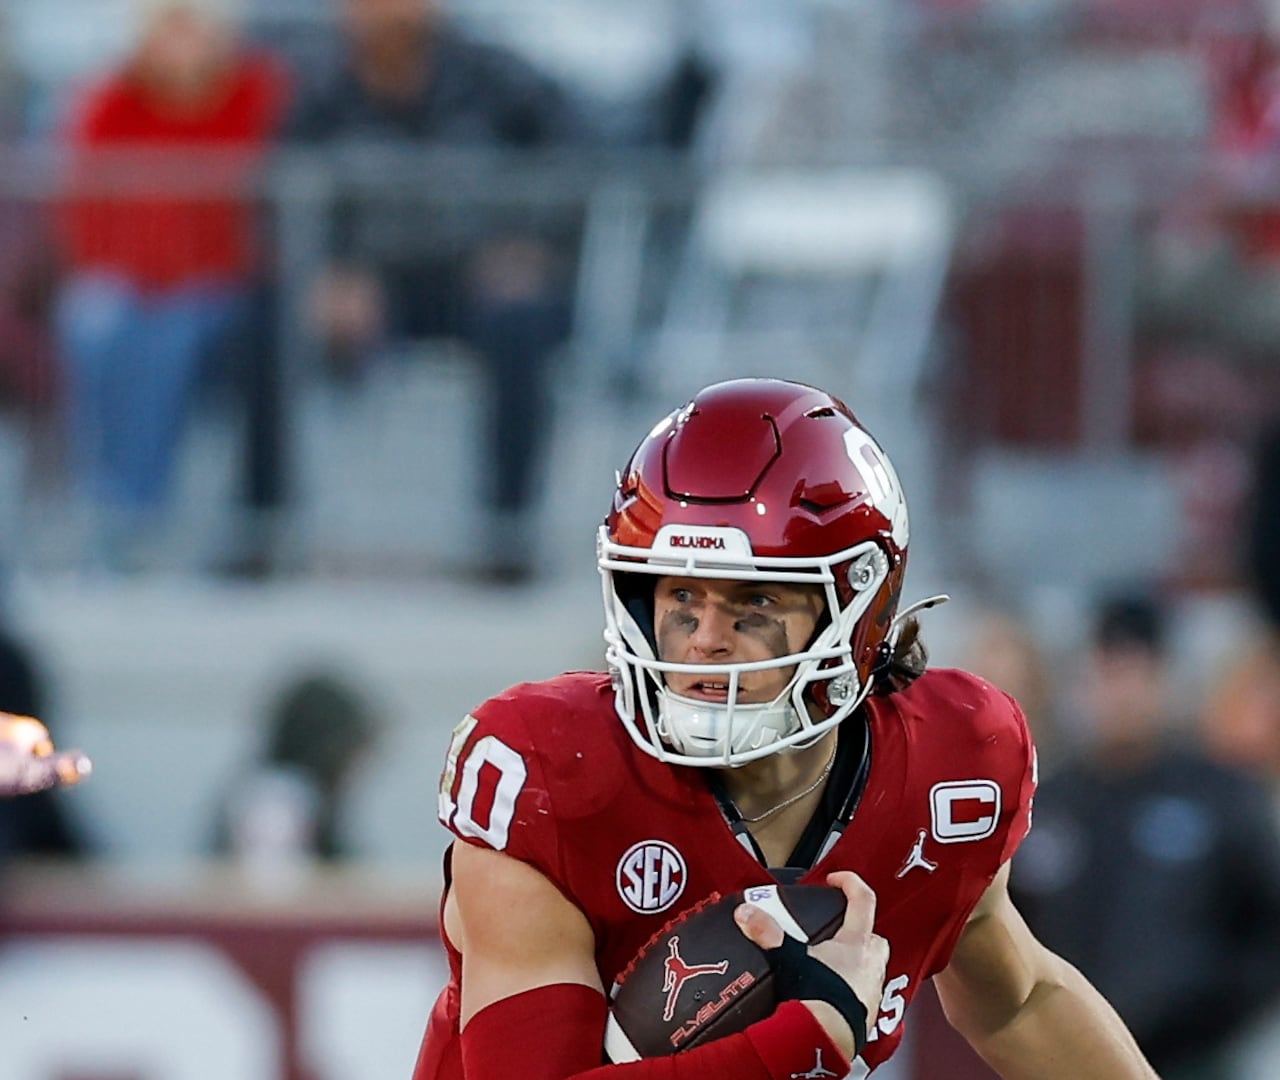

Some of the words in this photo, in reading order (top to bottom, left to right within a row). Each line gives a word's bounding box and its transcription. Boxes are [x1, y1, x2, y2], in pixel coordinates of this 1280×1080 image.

[670, 535, 726, 549] OKLAHOMA
[929, 780, 1001, 843] C
[622, 845, 681, 909] SEC
[670, 970, 756, 1047] FLYELITE
